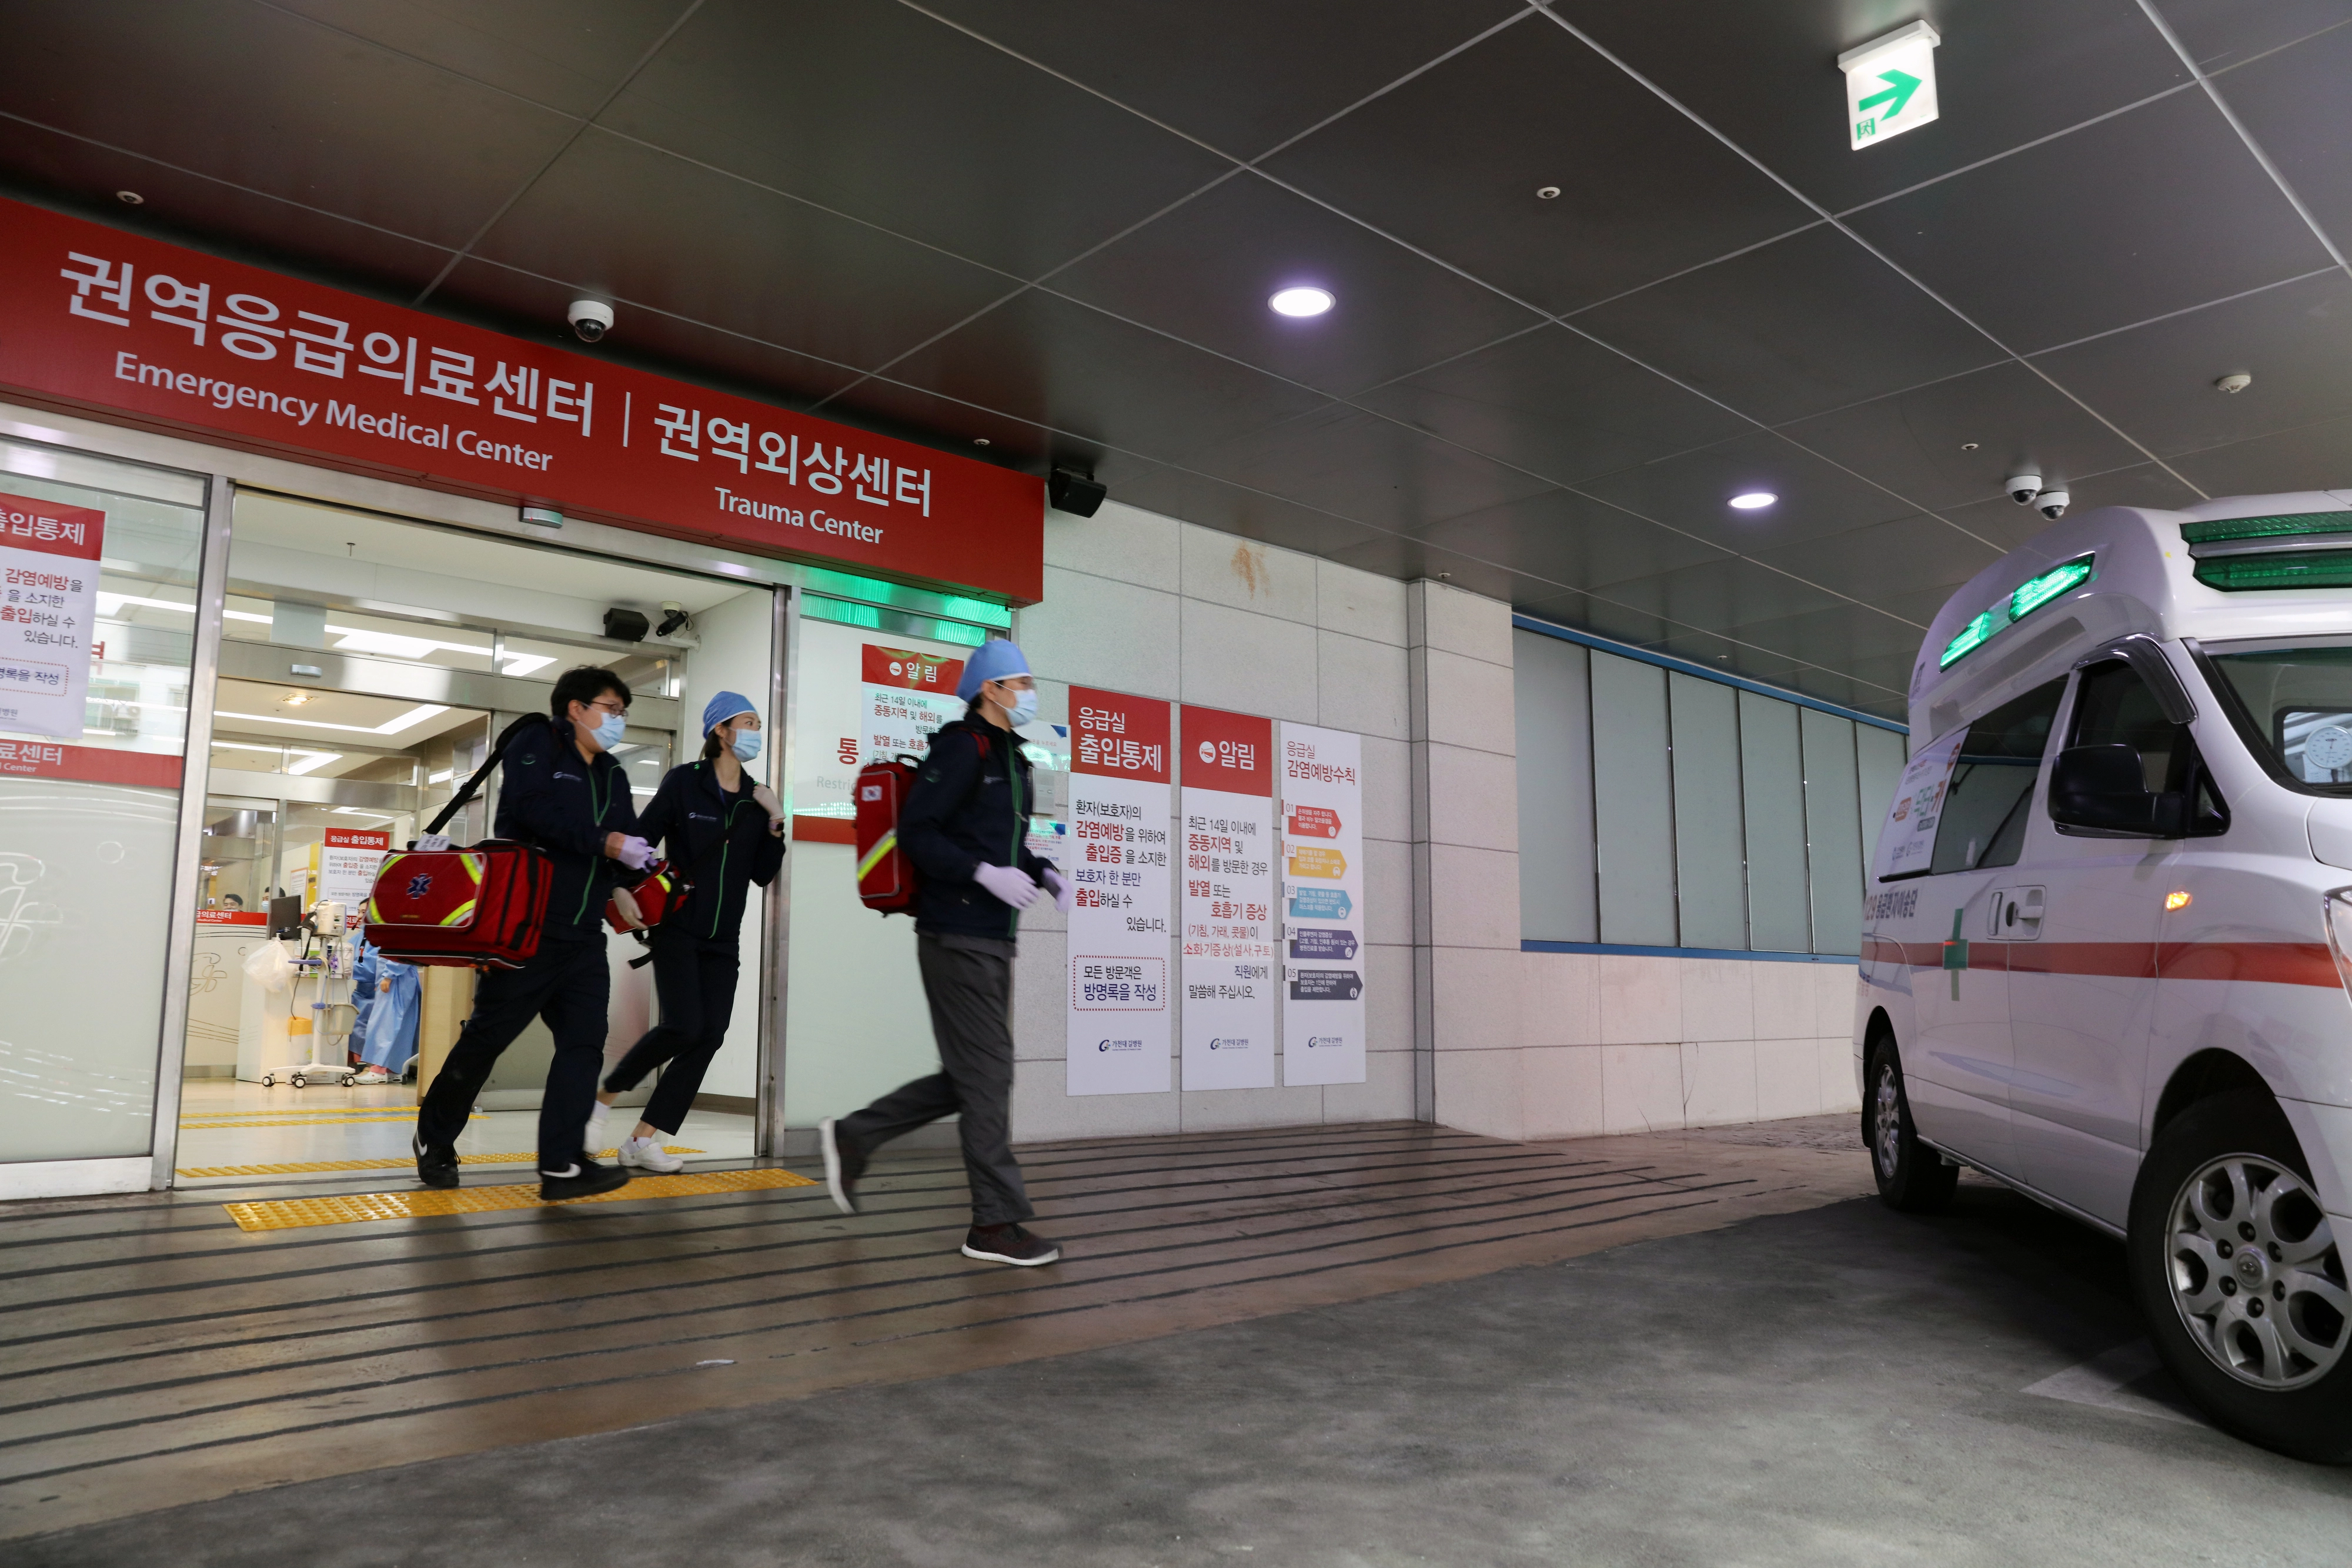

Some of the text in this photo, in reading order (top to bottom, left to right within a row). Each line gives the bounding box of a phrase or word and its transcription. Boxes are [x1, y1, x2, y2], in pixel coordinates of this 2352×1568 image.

[61, 251, 593, 437] 권역응급의료센터
[115, 351, 553, 471] Emergency Medical Center
[654, 403, 931, 517] 권역외상센터
[714, 487, 883, 544] Trauma Center
[25, 593, 65, 609] 소지한
[62, 617, 76, 628] 수
[24, 630, 78, 648] 있습니다.
[35, 671, 59, 686] 작성
[874, 693, 927, 709] 최근 14일 이내에
[874, 704, 943, 724] 중동지역 및 해외를
[1078, 706, 1125, 734] 응급실
[874, 734, 890, 747] 발열
[893, 738, 906, 748] 또는
[1078, 734, 1162, 773] 출입통제
[1219, 740, 1254, 771] 알림
[1287, 741, 1315, 760] 응급실
[4, 763, 37, 773] Center
[1287, 760, 1355, 786] 감염예방수칙
[1075, 800, 1141, 821] 환자(보호자)의
[1286, 803, 1294, 813] 01
[1188, 815, 1256, 836] 최근 14일 이내에
[350, 835, 384, 846] 출입통제
[1138, 828, 1165, 845] 위하여
[1188, 833, 1243, 854] 중동지역 및
[1085, 843, 1122, 864] 출입증
[1138, 851, 1167, 867] 소지한
[1286, 844, 1295, 854] 02
[1223, 859, 1249, 874] 방문한
[1251, 861, 1268, 876] 경우
[1075, 868, 1141, 887] 보호자 한 분만
[1189, 880, 1231, 898] 발열 또는
[1287, 885, 1295, 894] 03
[1122, 894, 1133, 908] 수
[1211, 901, 1267, 921] 호흡기 증상
[1127, 917, 1167, 932] 있습니다.
[1188, 923, 1209, 937] (기침,
[1211, 925, 1229, 938] 가래,
[1287, 927, 1296, 936] 04
[1084, 965, 1142, 979] 모든 방문객은
[1235, 965, 1268, 979] 직원에게
[1287, 968, 1296, 978] 05
[1084, 983, 1157, 1001] 방명록을 작성
[1189, 984, 1216, 999] 말씀해
